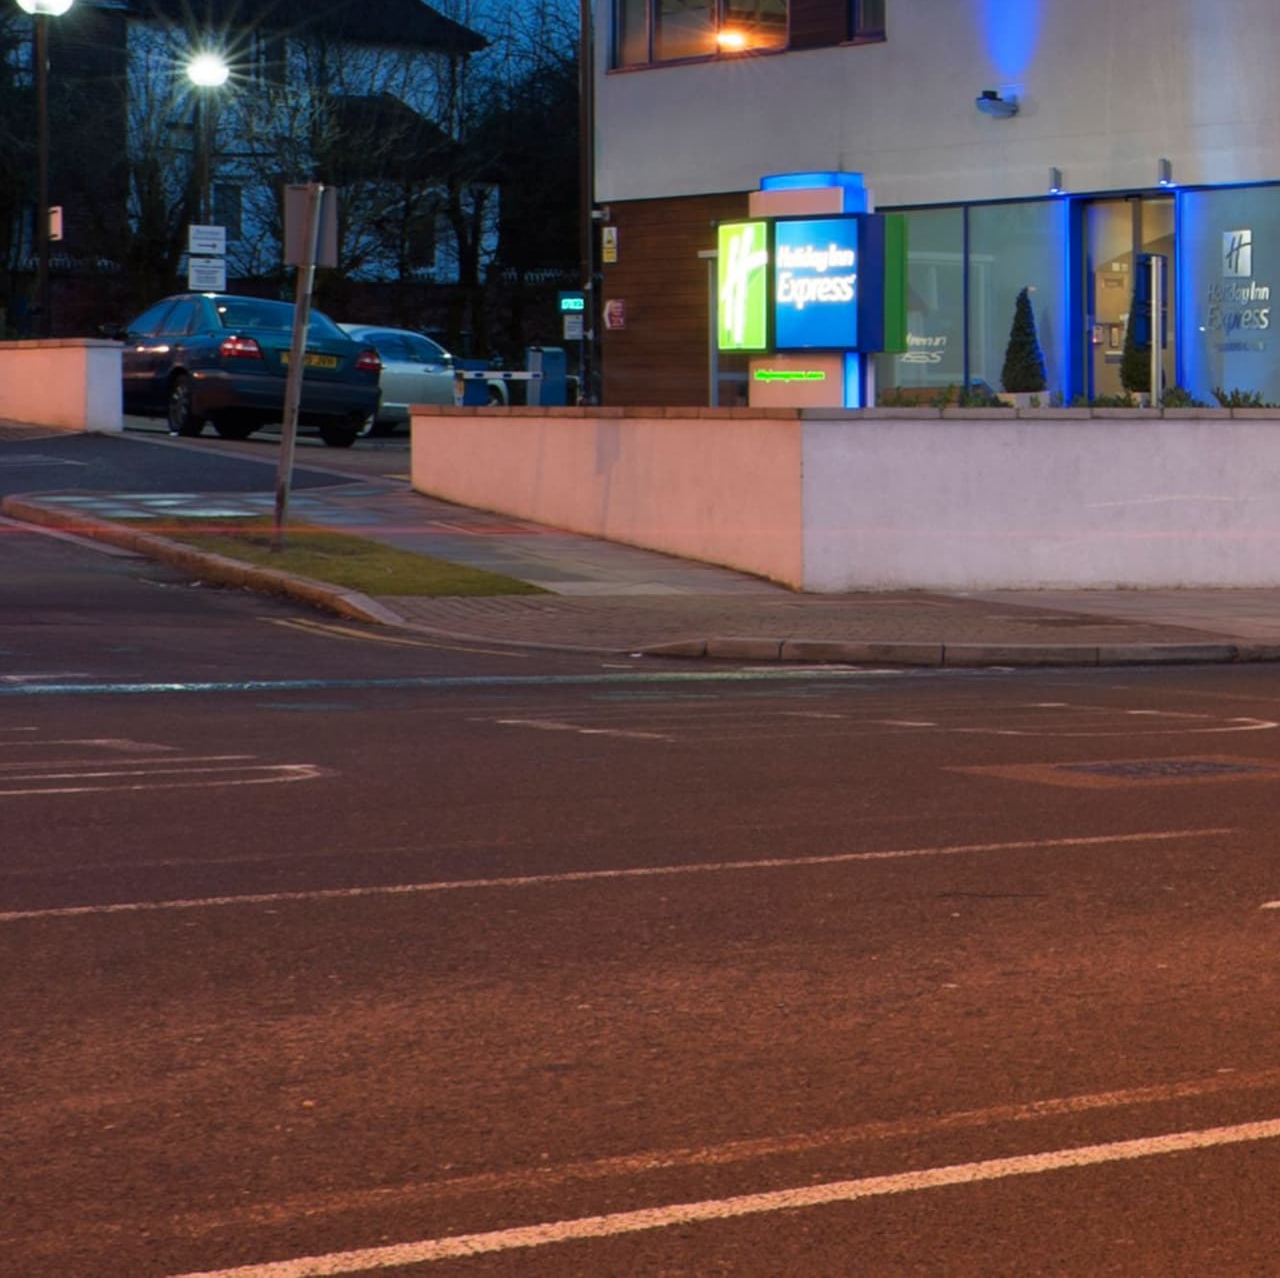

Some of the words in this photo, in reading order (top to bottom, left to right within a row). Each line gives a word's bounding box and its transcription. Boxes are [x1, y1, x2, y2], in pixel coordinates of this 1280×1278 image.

[777, 245, 828, 272] Holiday
[777, 271, 857, 310] Express
[1250, 281, 1270, 301] Inn
[1207, 305, 1270, 337] Express
